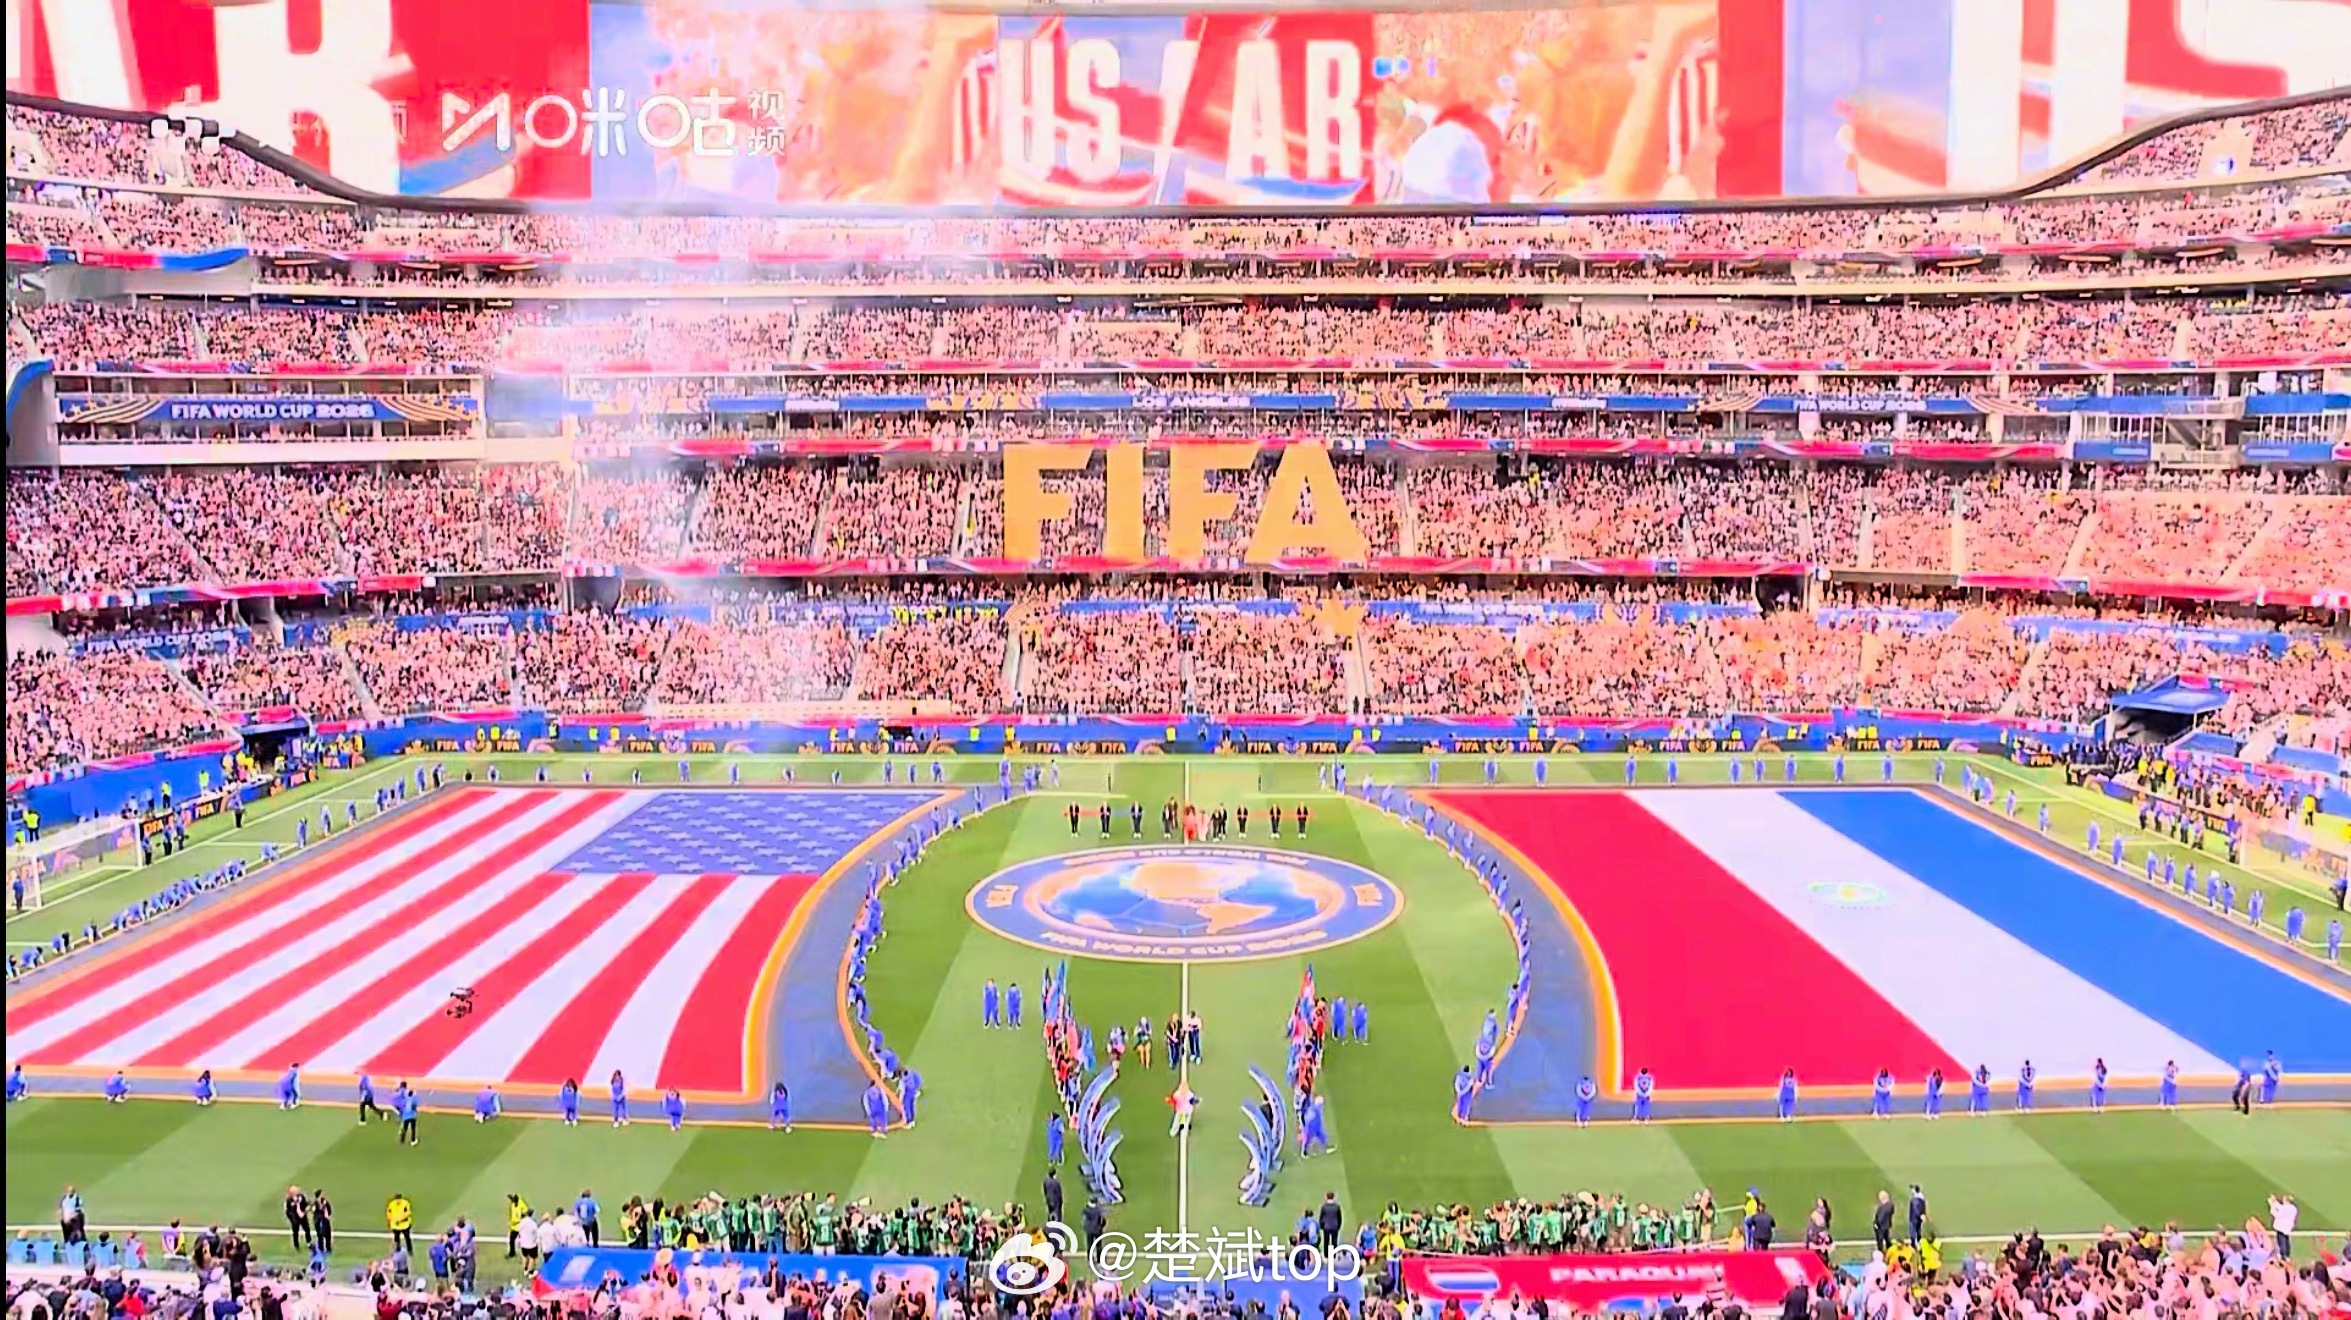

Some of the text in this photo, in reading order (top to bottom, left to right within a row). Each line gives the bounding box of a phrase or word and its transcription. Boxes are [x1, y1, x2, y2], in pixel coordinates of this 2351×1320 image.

[171, 404, 376, 419] FIFA WORLD CUP 2026
[1002, 440, 1368, 566] FIFA
[1092, 941, 1187, 955] WORLD
[1190, 944, 1243, 955] CUP
